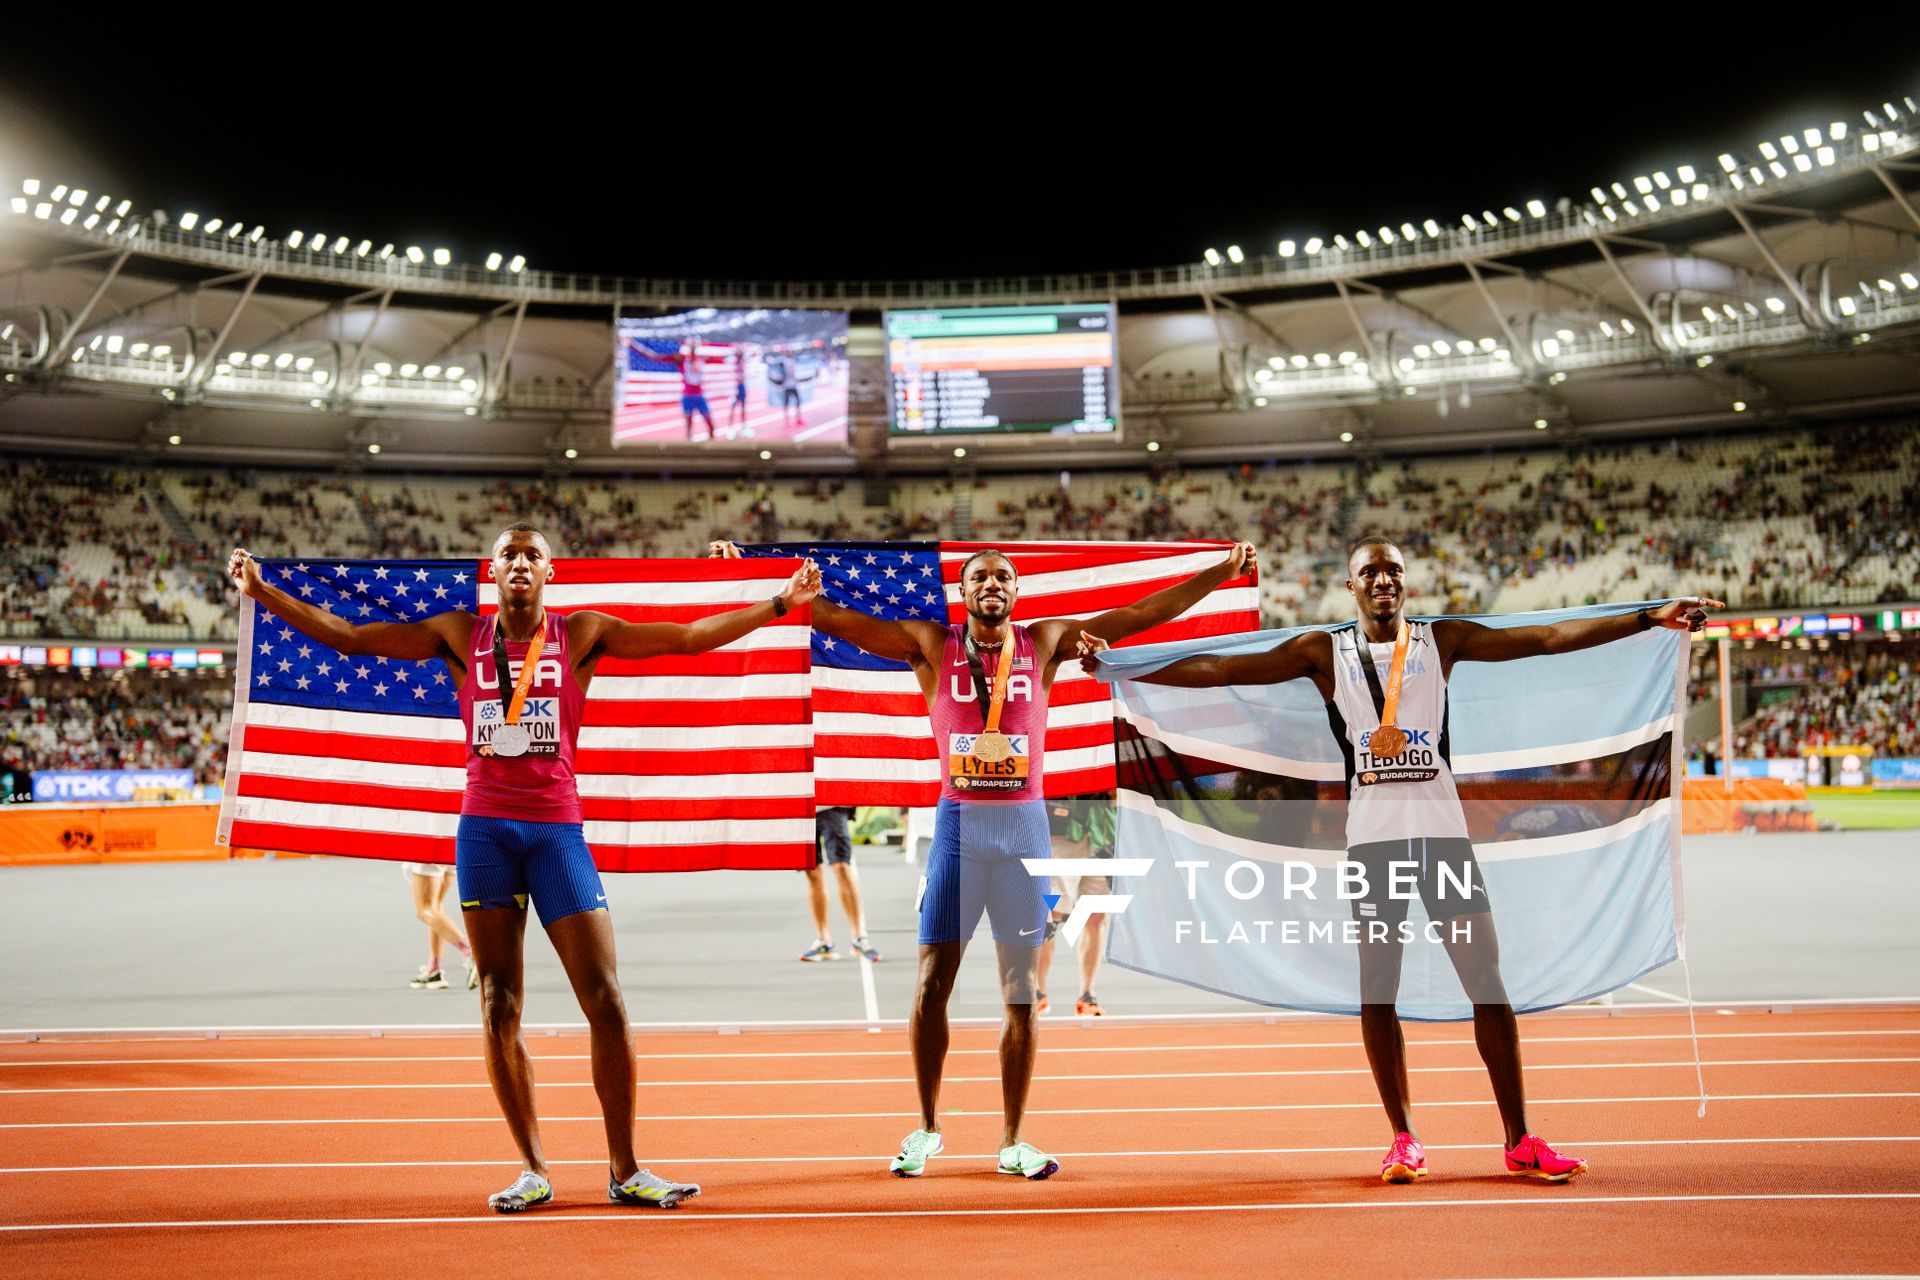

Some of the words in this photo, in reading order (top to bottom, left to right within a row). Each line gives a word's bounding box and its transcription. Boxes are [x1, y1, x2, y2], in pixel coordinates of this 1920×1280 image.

[962, 757, 1016, 775] LYLES
[1380, 771, 1424, 780] BUDAPEST
[53, 775, 111, 797] TDK
[971, 780, 1013, 788] BUDAPEST
